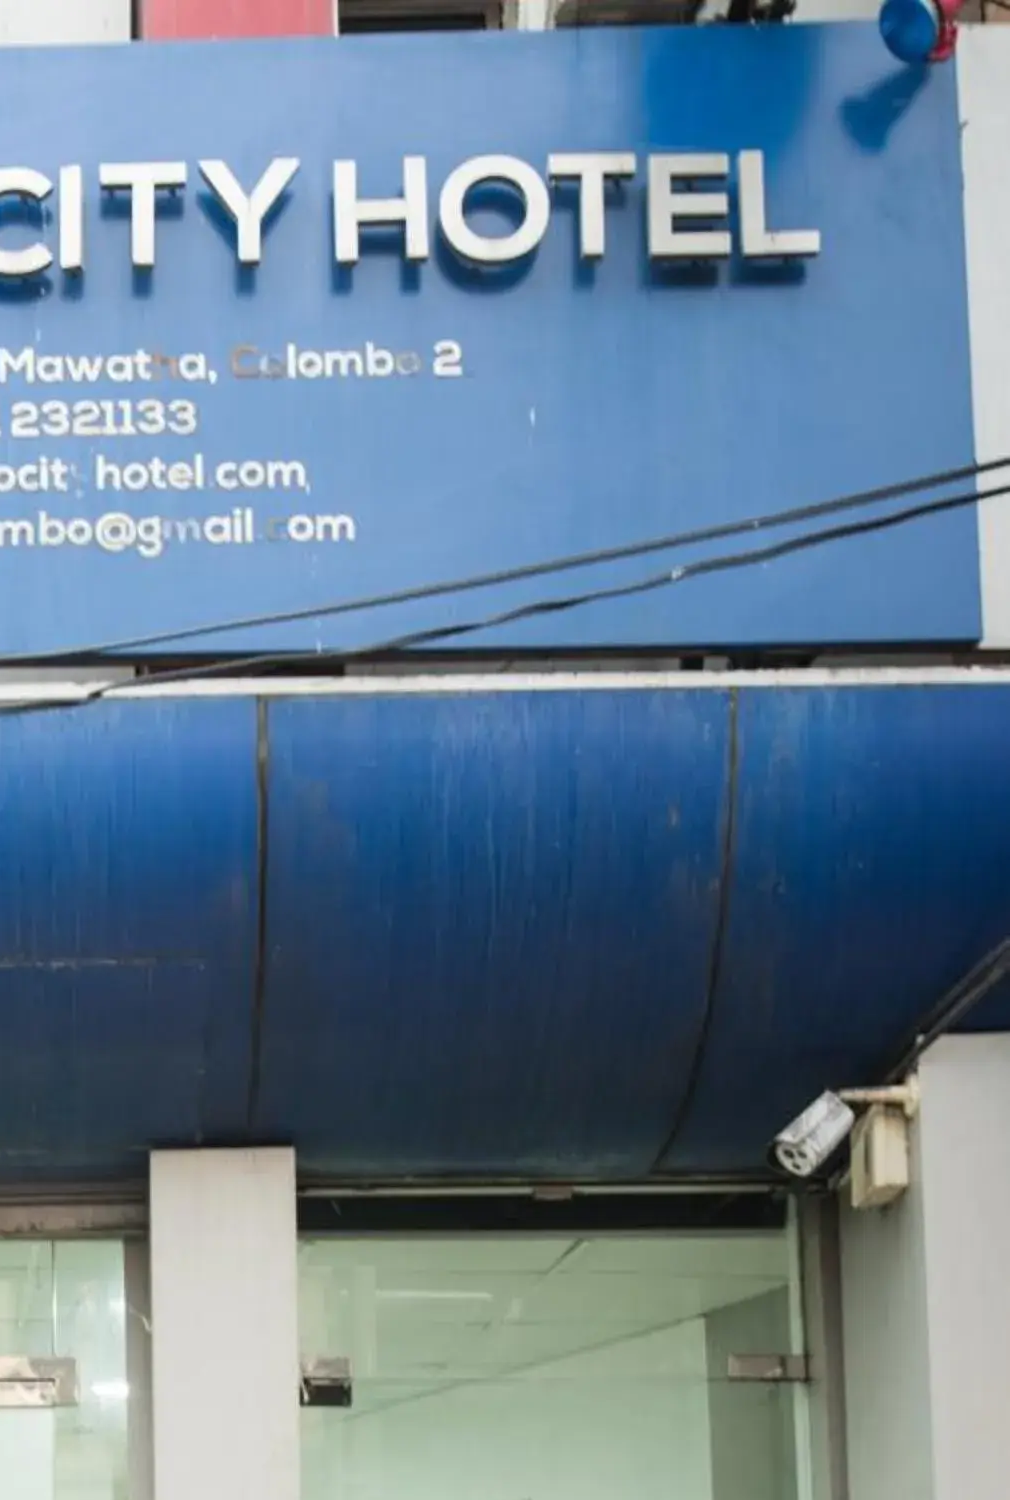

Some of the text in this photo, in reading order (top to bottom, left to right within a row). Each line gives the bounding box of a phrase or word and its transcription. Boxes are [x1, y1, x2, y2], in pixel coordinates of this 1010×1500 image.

[332, 149, 821, 265] HOTEL
[432, 339, 464, 378] 2
[10, 398, 198, 438] 2321133
